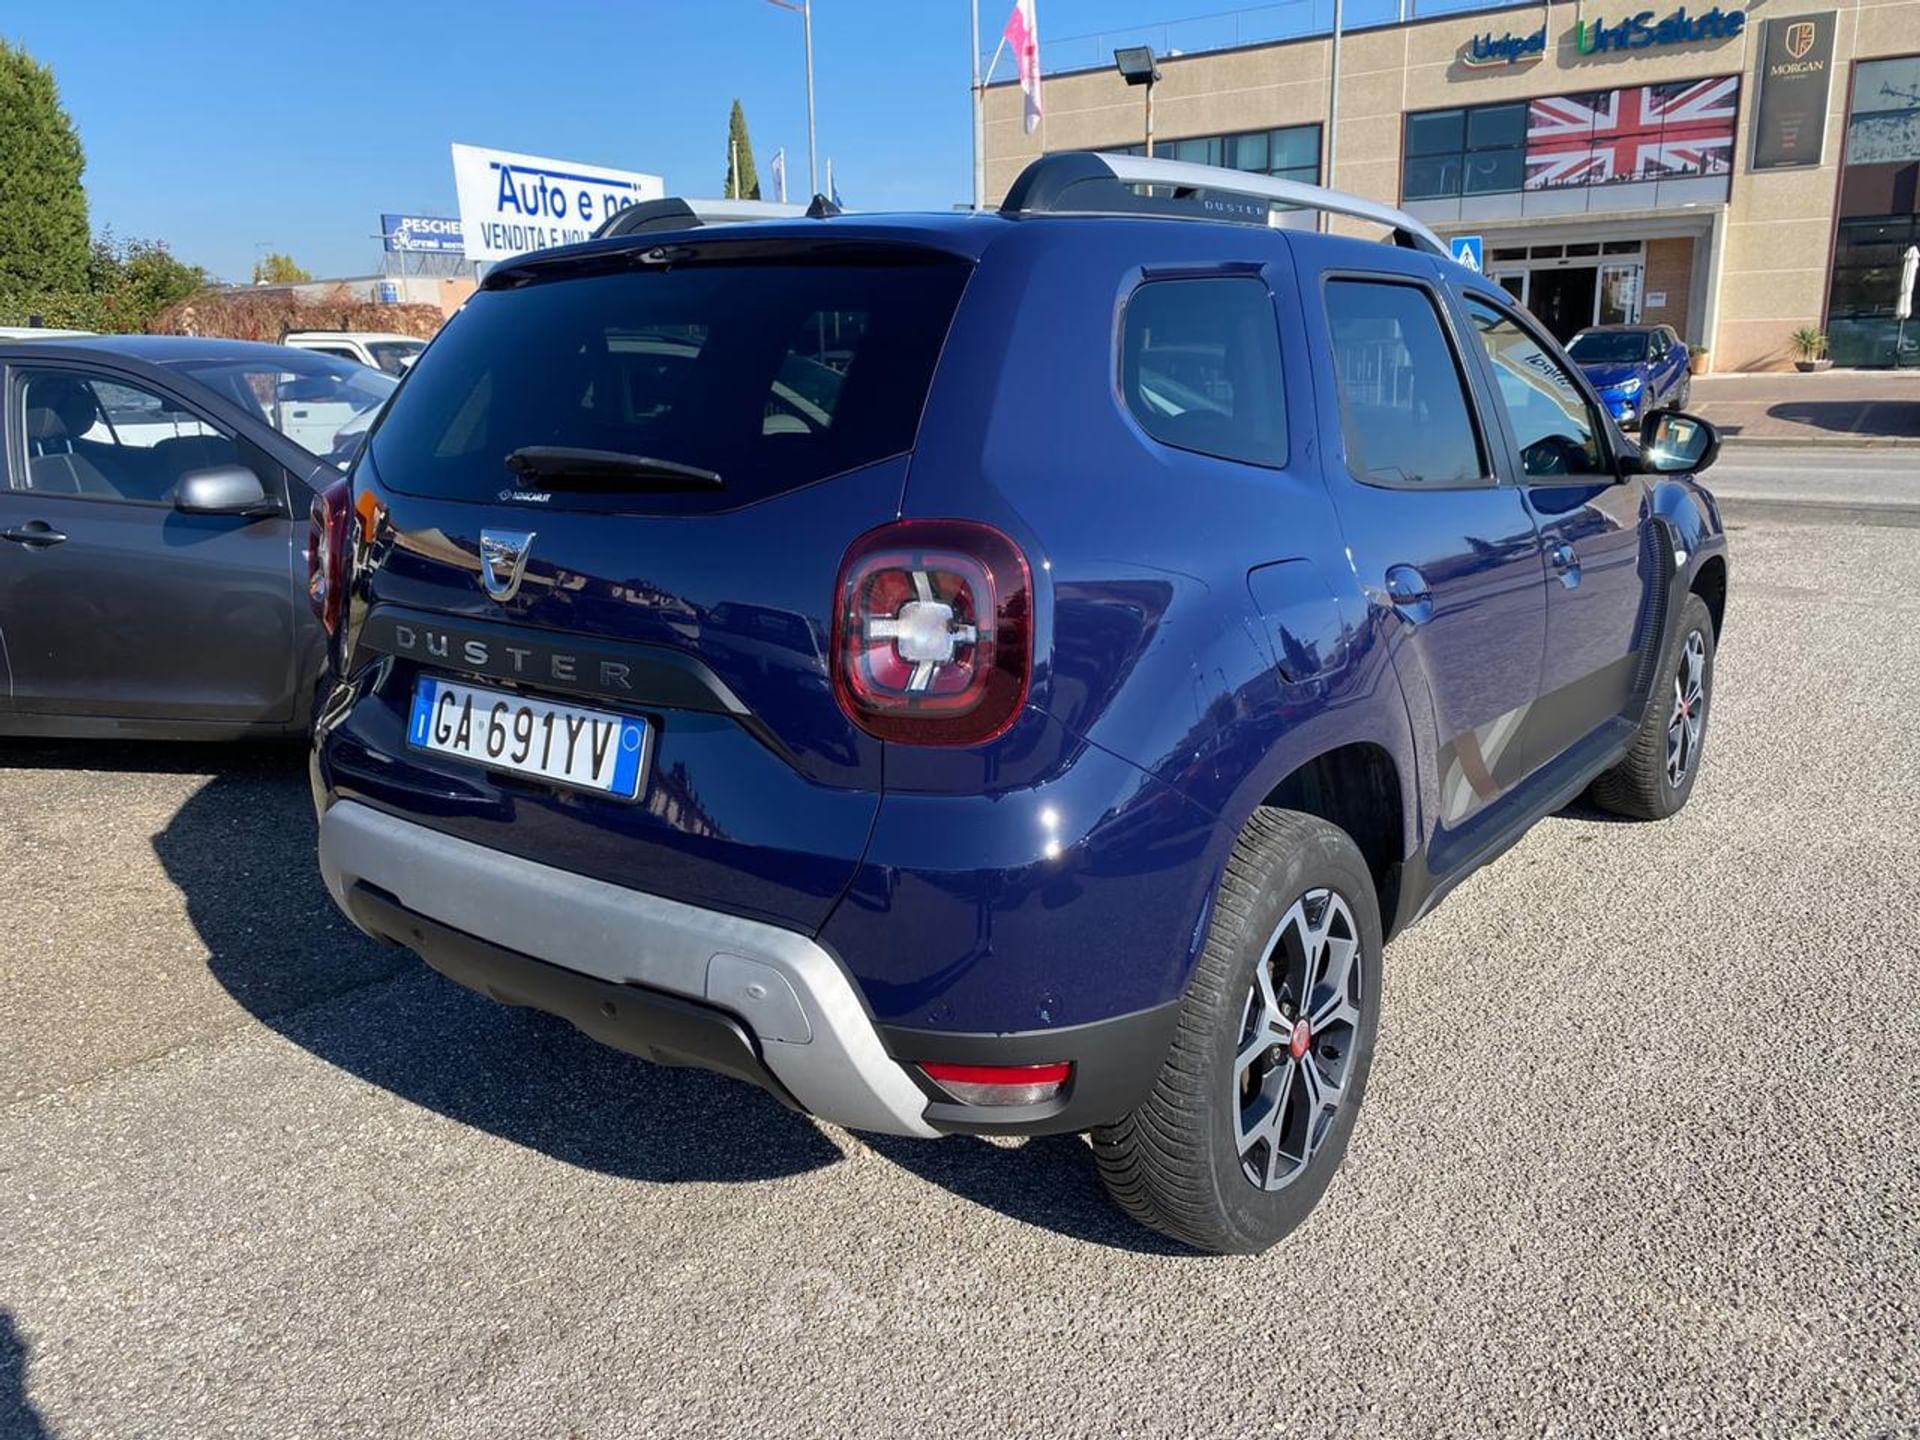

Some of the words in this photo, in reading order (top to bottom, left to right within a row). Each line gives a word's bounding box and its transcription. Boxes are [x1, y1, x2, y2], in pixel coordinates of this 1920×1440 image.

[1472, 24, 1546, 62] Unipol
[1577, 6, 1746, 55] UniSalute
[1770, 60, 1824, 76] MORGAN
[497, 165, 567, 219] Auto
[578, 190, 593, 222] e
[481, 222, 547, 251] VENDITA
[395, 625, 633, 690] DUSTER
